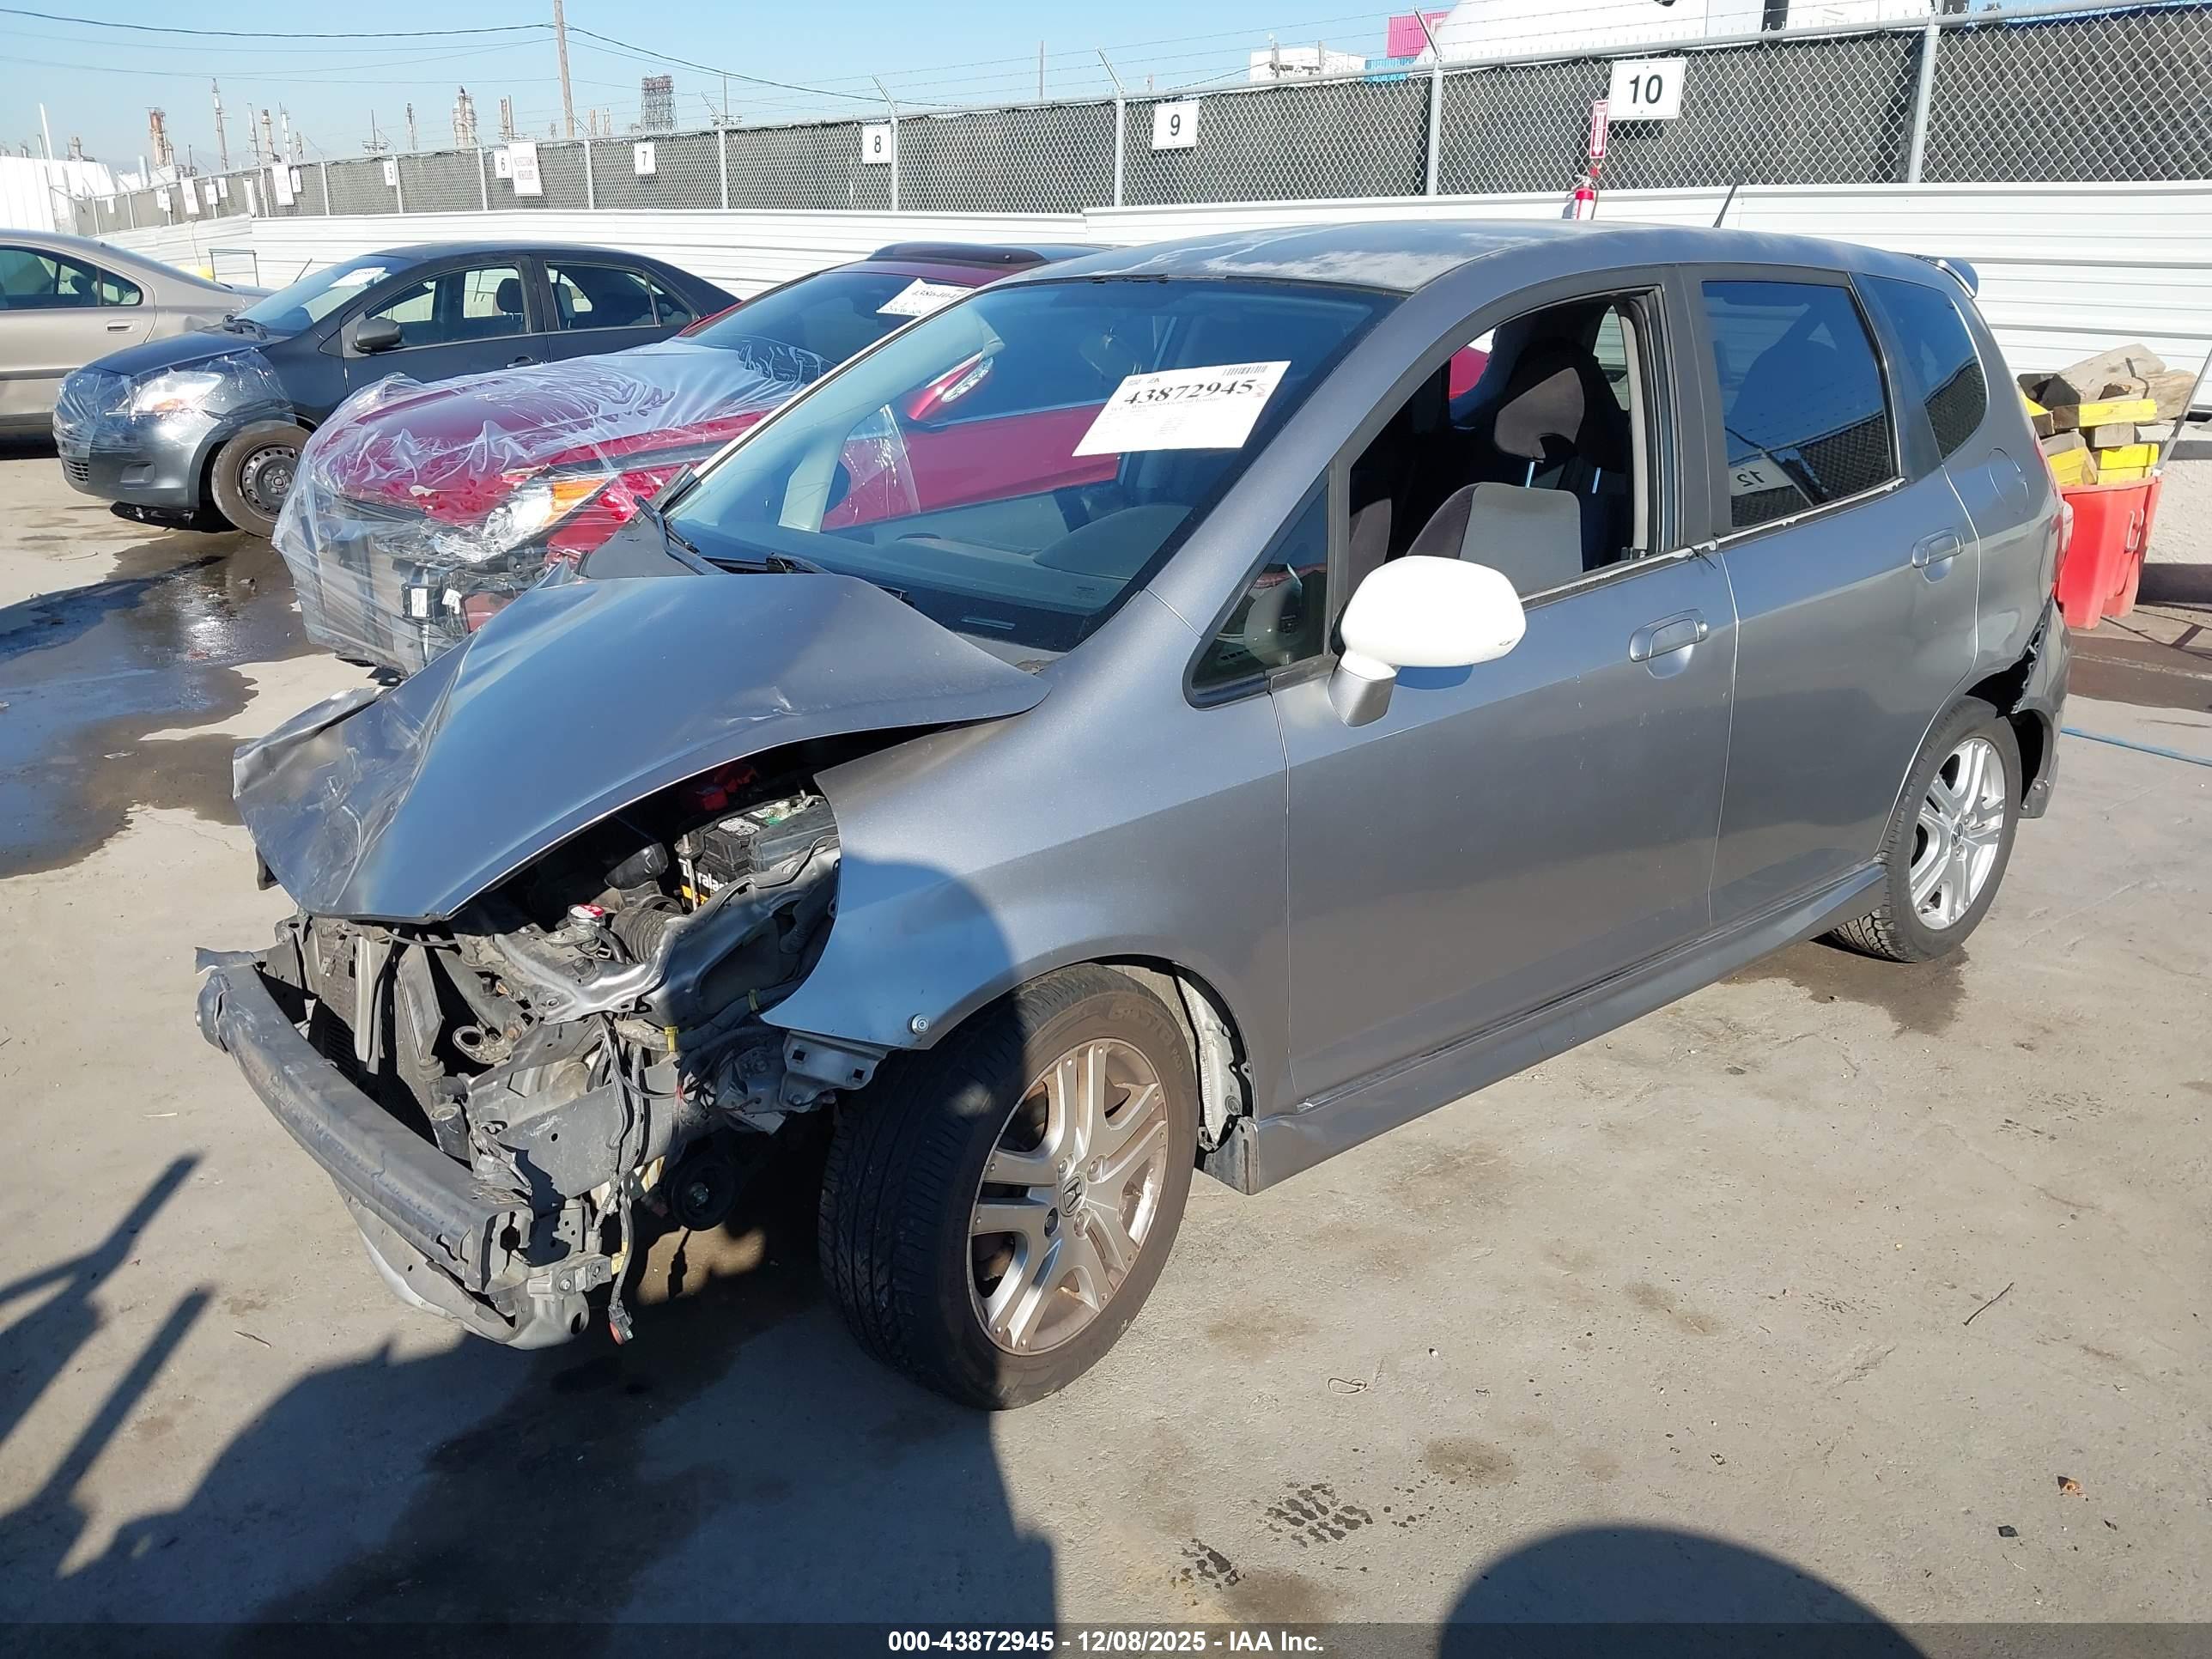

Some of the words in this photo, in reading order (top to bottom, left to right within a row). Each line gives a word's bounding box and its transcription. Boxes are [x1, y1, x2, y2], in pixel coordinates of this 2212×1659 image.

[1629, 74, 1663, 104] 10
[1170, 113, 1181, 137] 9
[874, 135, 882, 154] 8
[501, 157, 506, 172] 6
[641, 150, 647, 166] 7
[1124, 380, 1257, 404] 43872945
